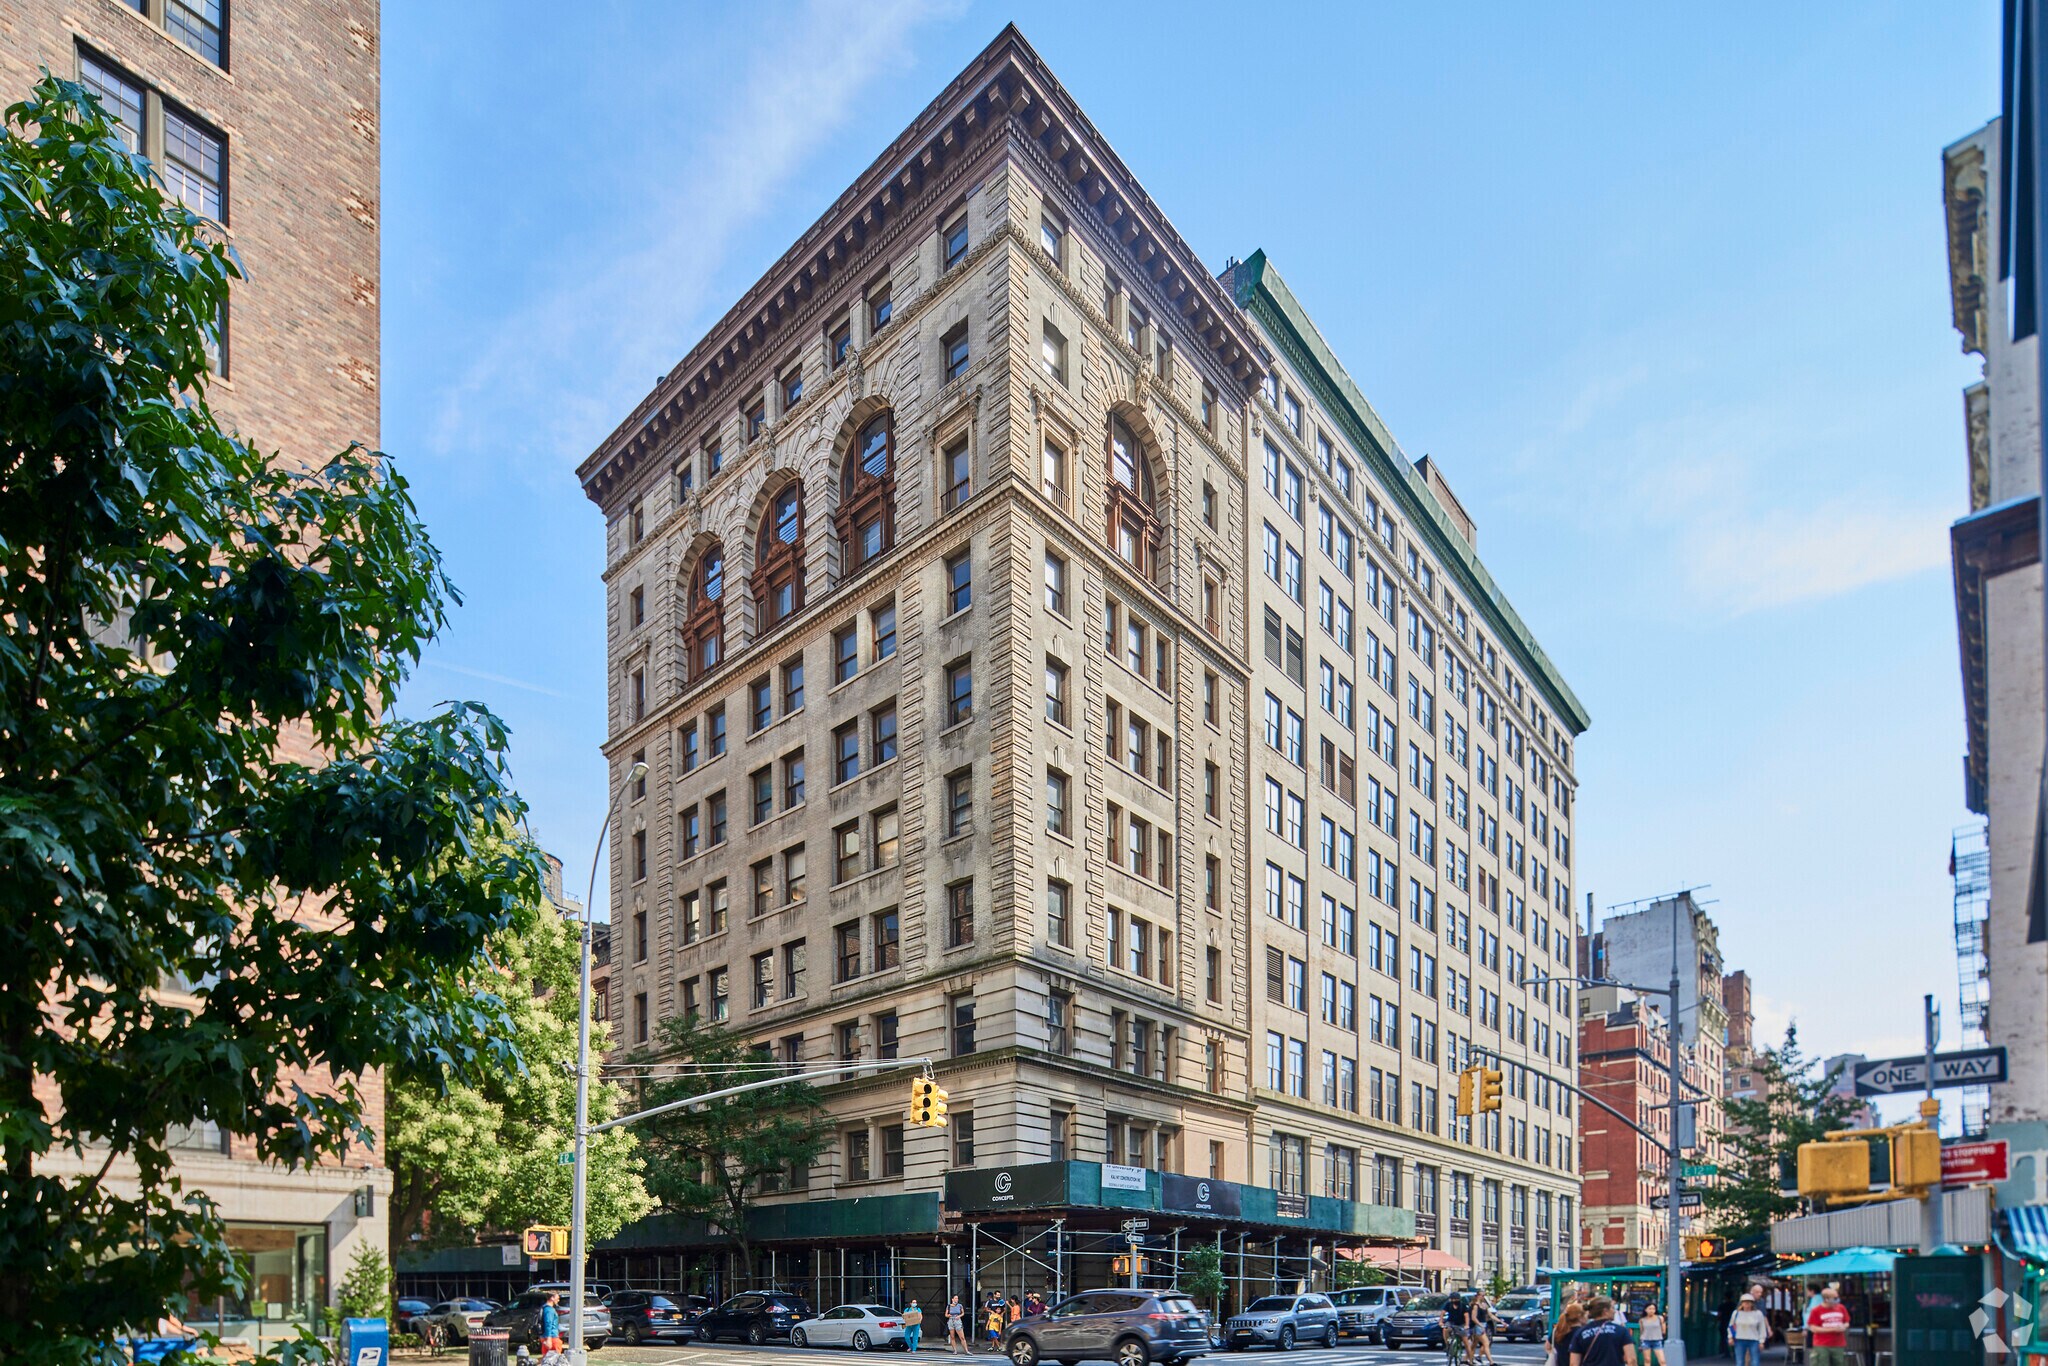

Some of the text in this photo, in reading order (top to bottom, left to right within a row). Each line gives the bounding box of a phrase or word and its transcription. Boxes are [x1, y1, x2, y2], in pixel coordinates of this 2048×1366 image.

[1873, 1058, 1992, 1085] ONE WAY
[1953, 1145, 1996, 1158] STOPPING
[1685, 1168, 1690, 1176] E
[1694, 1166, 1704, 1175] 12
